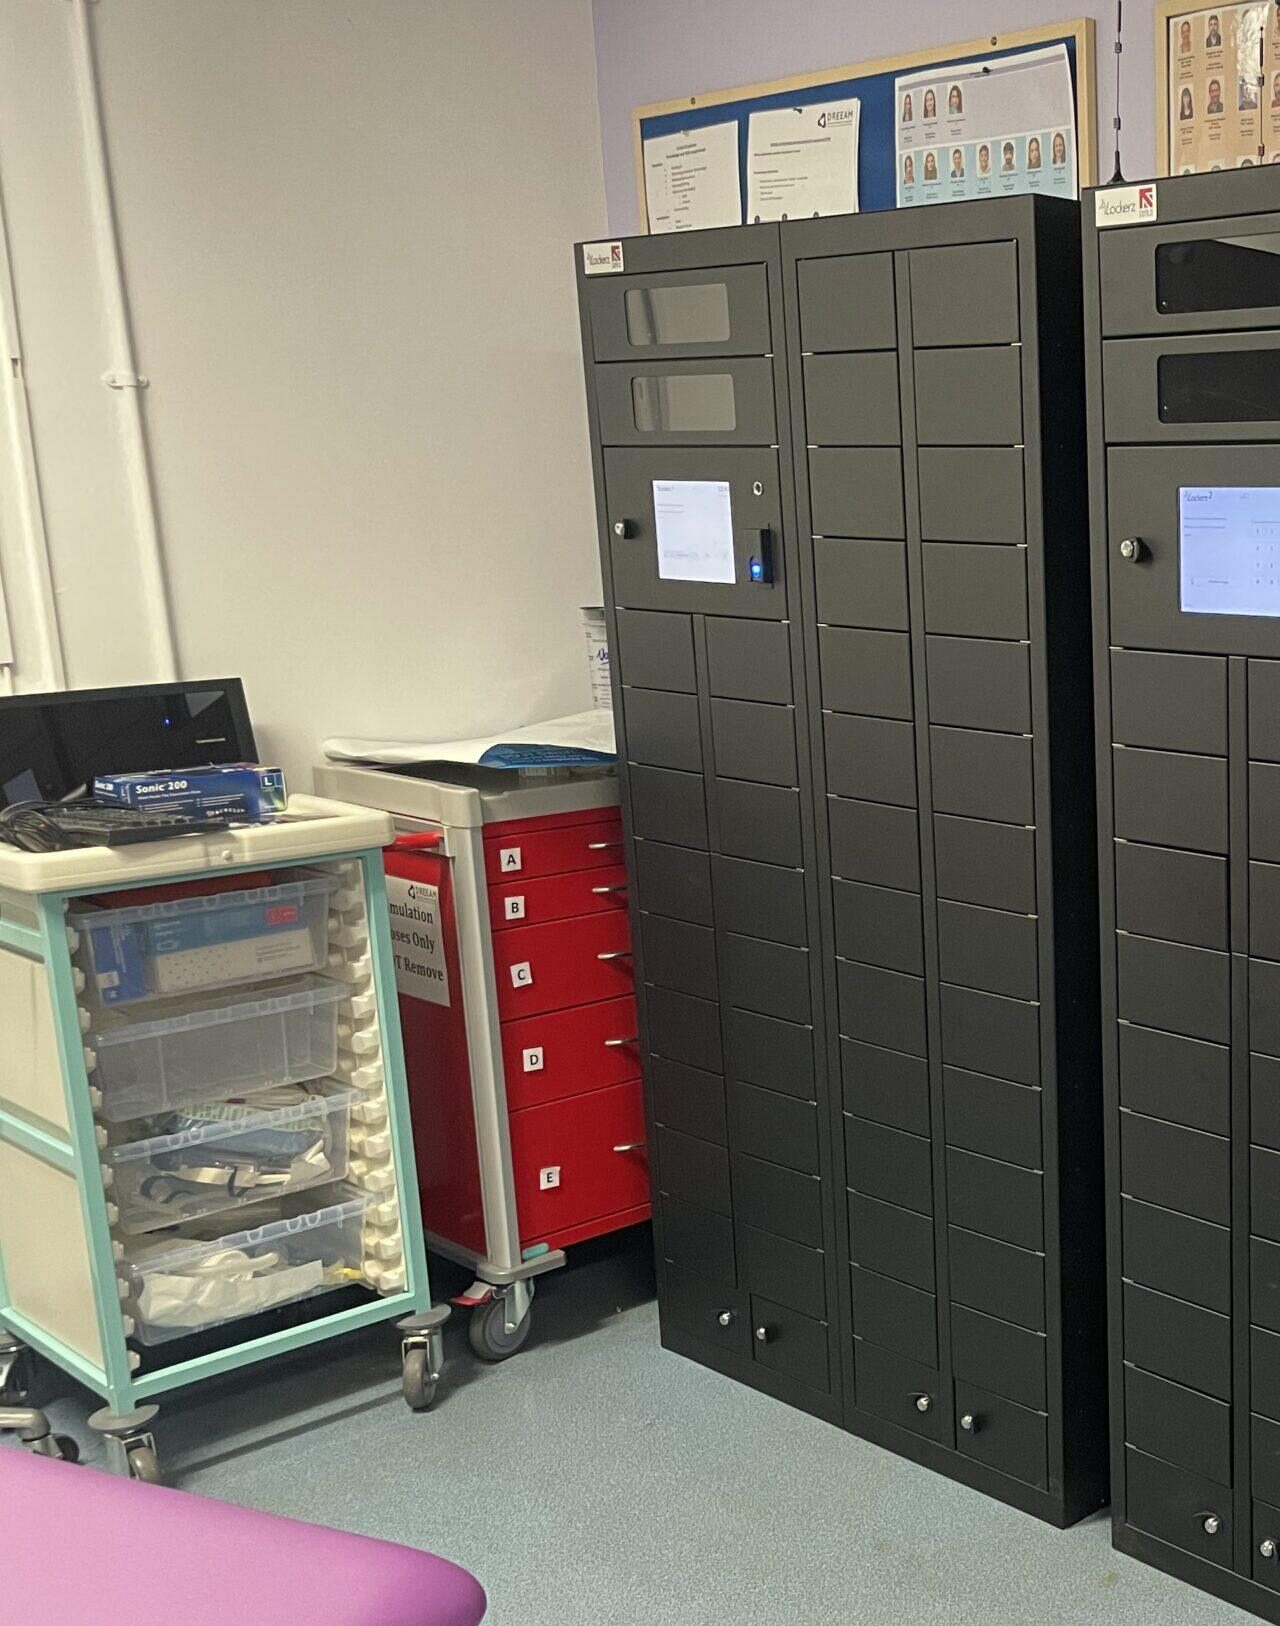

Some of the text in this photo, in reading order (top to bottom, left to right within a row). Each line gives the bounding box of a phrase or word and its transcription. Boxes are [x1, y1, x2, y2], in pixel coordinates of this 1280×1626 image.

[135, 783, 165, 794] Sonic
[167, 780, 188, 791] 200
[264, 776, 273, 786] L
[506, 854, 516, 866] A
[390, 902, 434, 925] mulation
[511, 902, 519, 913] B
[412, 931, 435, 955] Only
[403, 956, 444, 982] Remove
[517, 969, 526, 980] C
[529, 1054, 539, 1066] D
[546, 1172, 553, 1183] E
